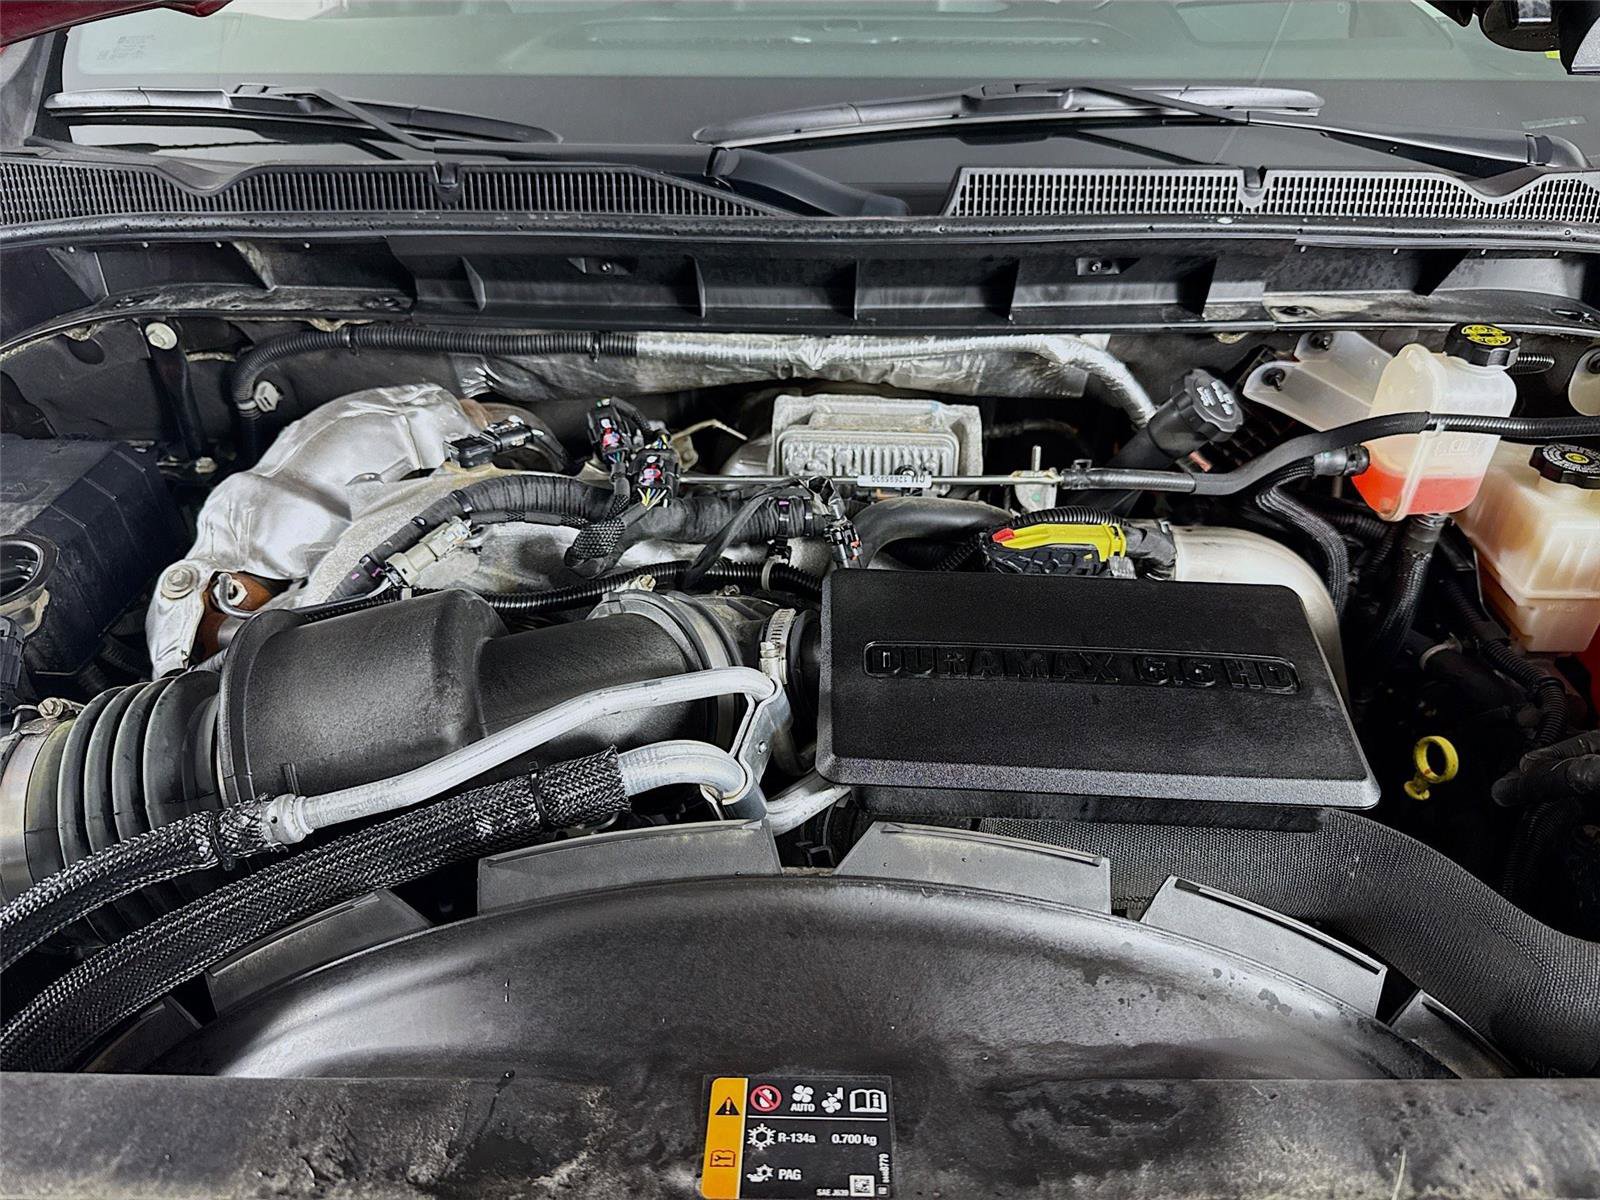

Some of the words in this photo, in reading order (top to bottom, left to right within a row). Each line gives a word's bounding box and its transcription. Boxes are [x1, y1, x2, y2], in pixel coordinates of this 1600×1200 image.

[872, 645, 1120, 681] DURAMAX
[1133, 655, 1216, 686] 6.6
[1224, 659, 1298, 694] HD
[790, 1102, 816, 1113] AUTO
[777, 1132, 816, 1144] R-134a
[831, 1133, 862, 1145] 0.700
[863, 1134, 878, 1147] kg
[778, 1168, 802, 1181] PAG
[816, 1188, 831, 1197] SAE
